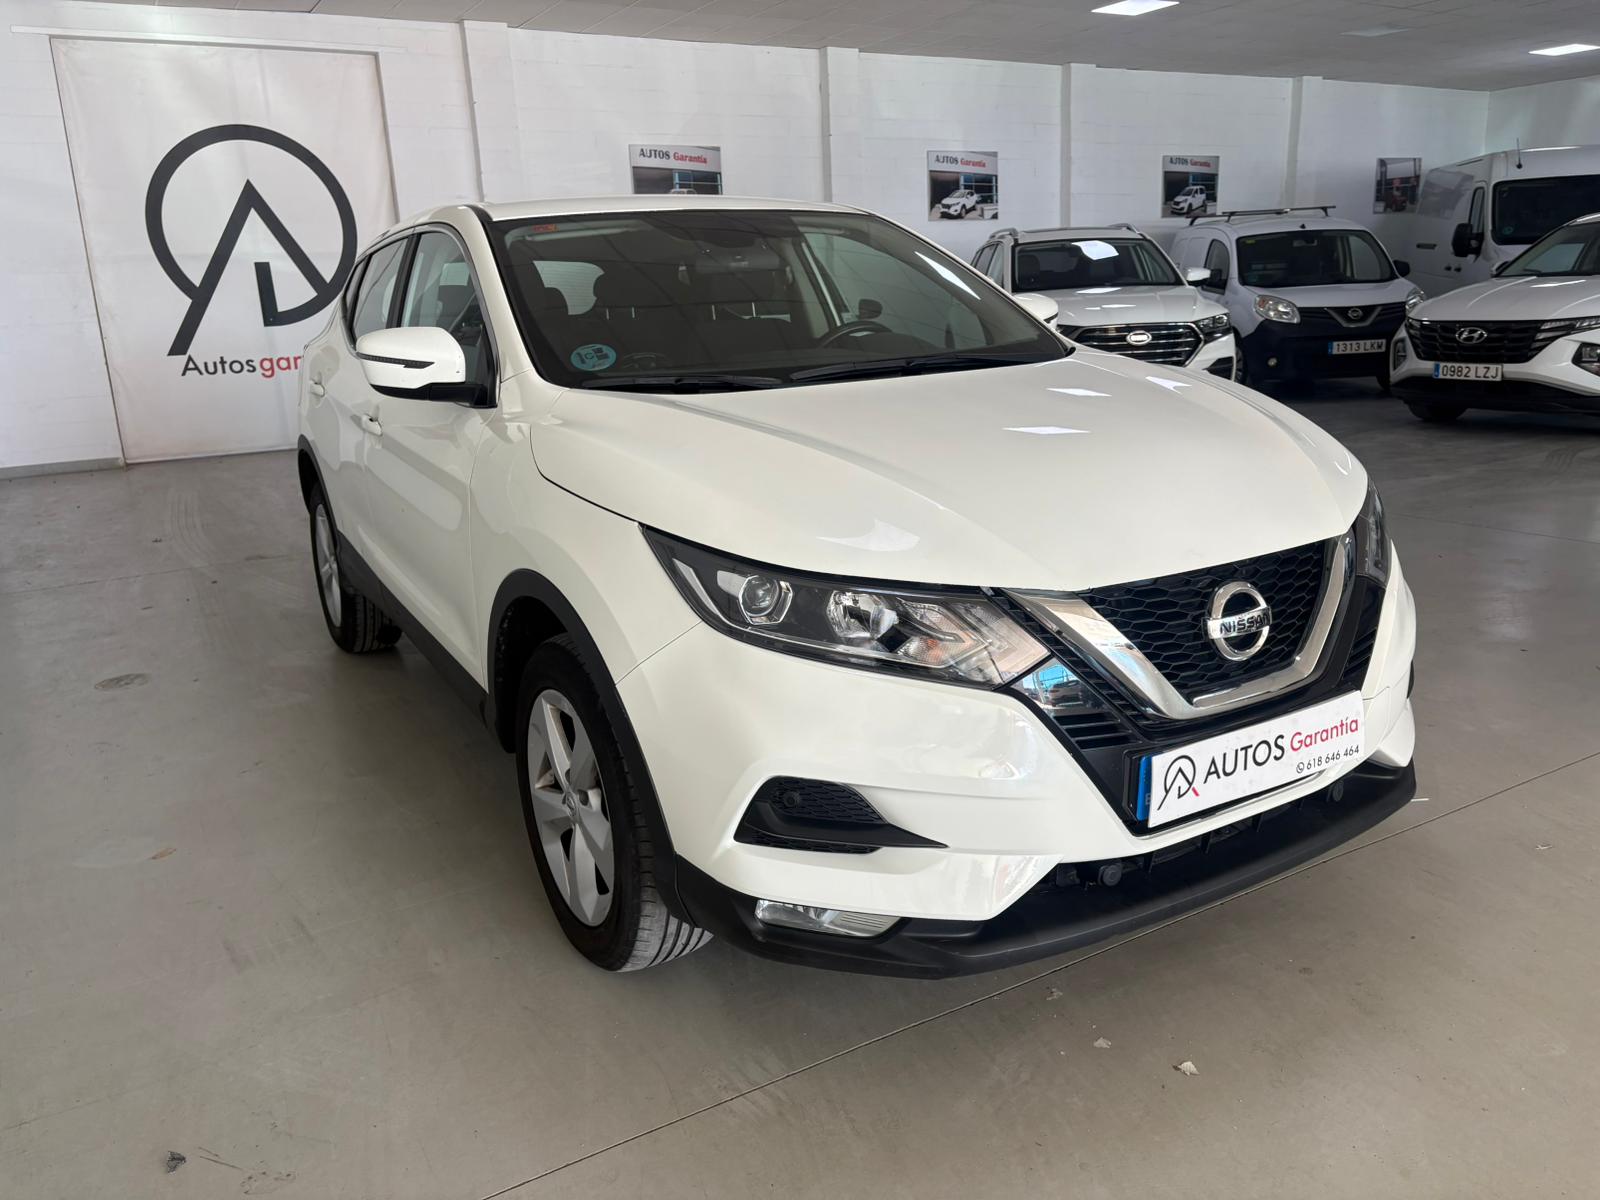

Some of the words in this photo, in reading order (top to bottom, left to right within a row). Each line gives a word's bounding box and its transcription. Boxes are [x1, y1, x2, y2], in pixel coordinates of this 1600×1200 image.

[639, 147, 671, 160] AUTOS
[1336, 342, 1361, 353] 1313
[1441, 364, 1472, 378] 0982
[1474, 366, 1499, 379] LZJ
[1219, 613, 1271, 634] NISSAN
[1203, 734, 1285, 784] AUTOS
[1289, 716, 1359, 752] Garantía
[1306, 758, 1323, 772] 618
[1324, 752, 1341, 765] 646
[1343, 745, 1360, 759] 464
